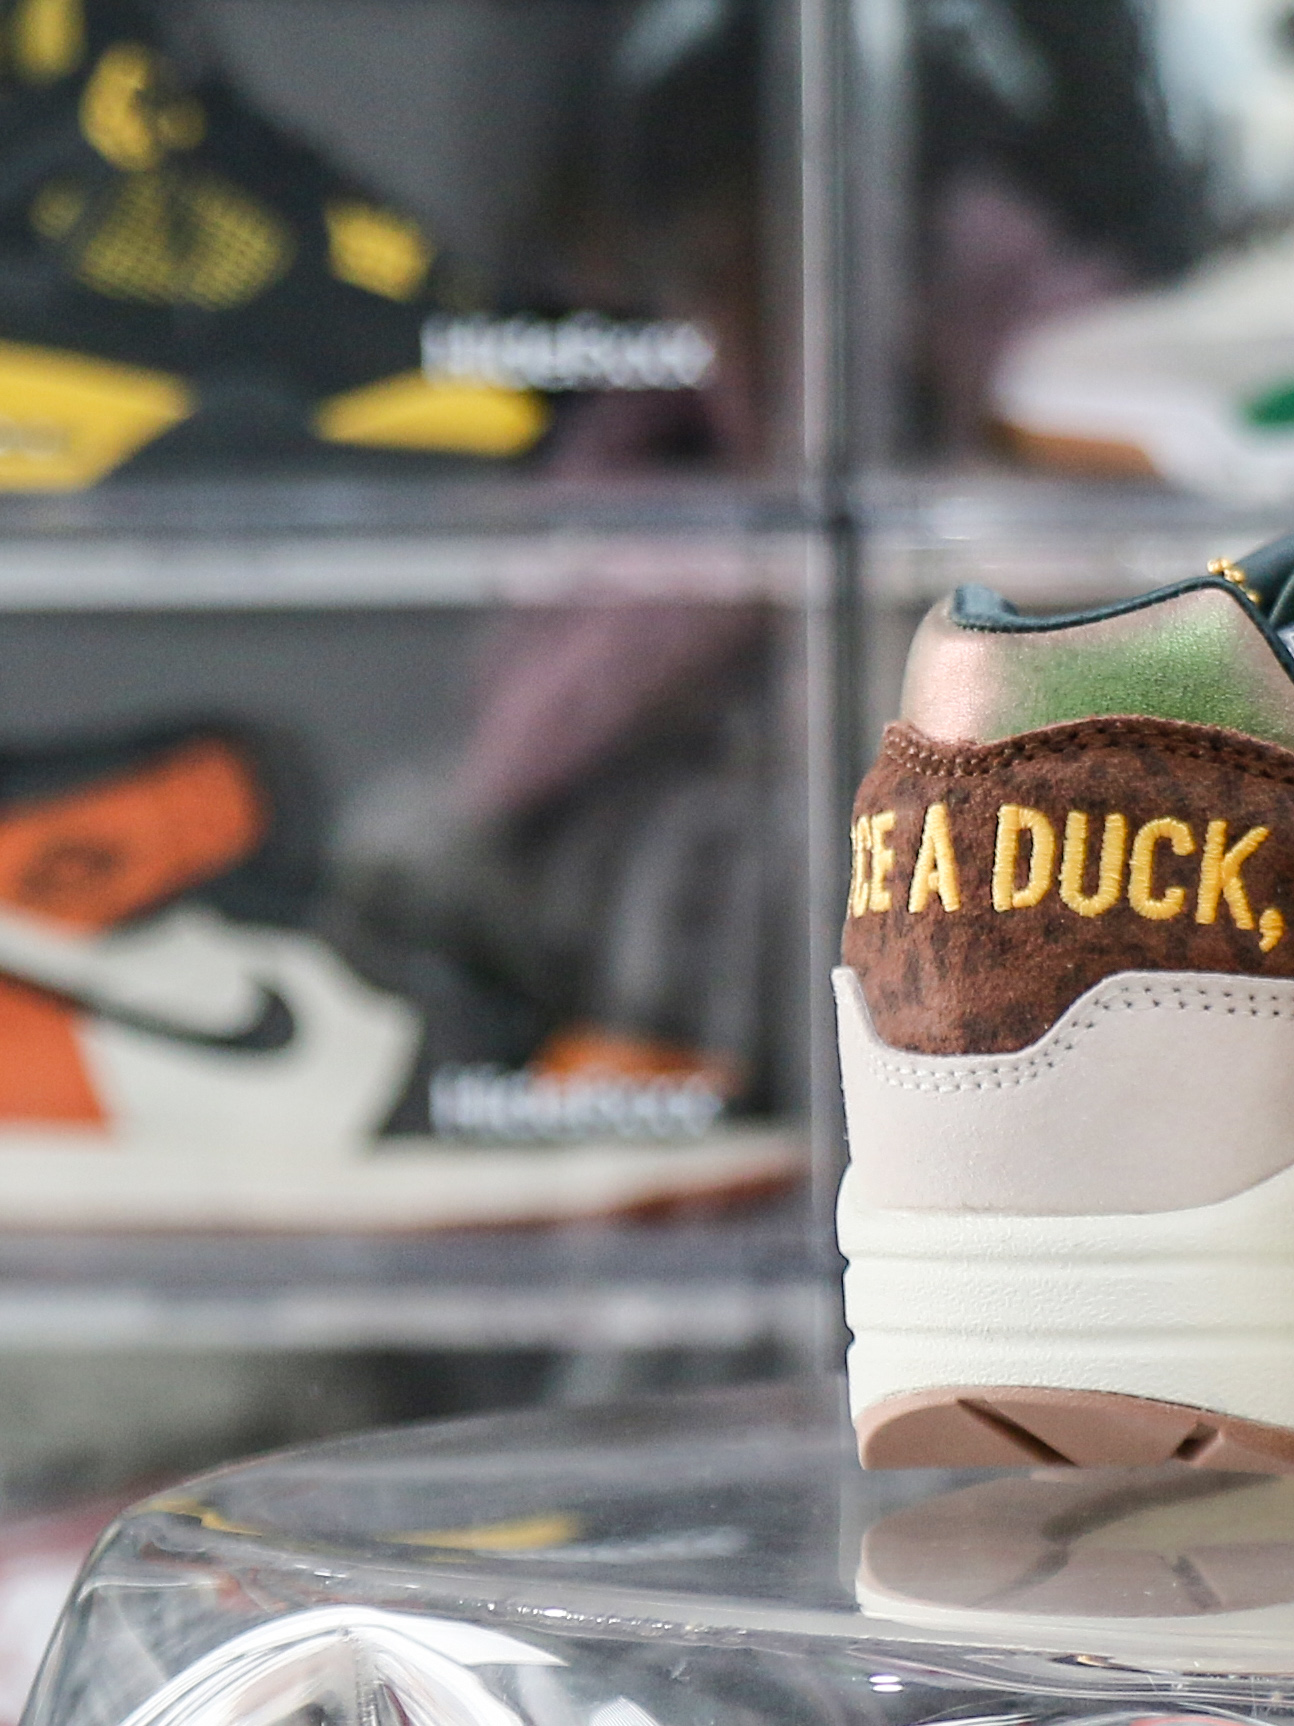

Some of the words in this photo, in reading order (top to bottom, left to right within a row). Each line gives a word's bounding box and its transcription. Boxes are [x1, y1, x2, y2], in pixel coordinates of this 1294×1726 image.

[848, 810, 896, 918] CE
[908, 803, 961, 913] A
[992, 804, 1284, 952] DUCK,
